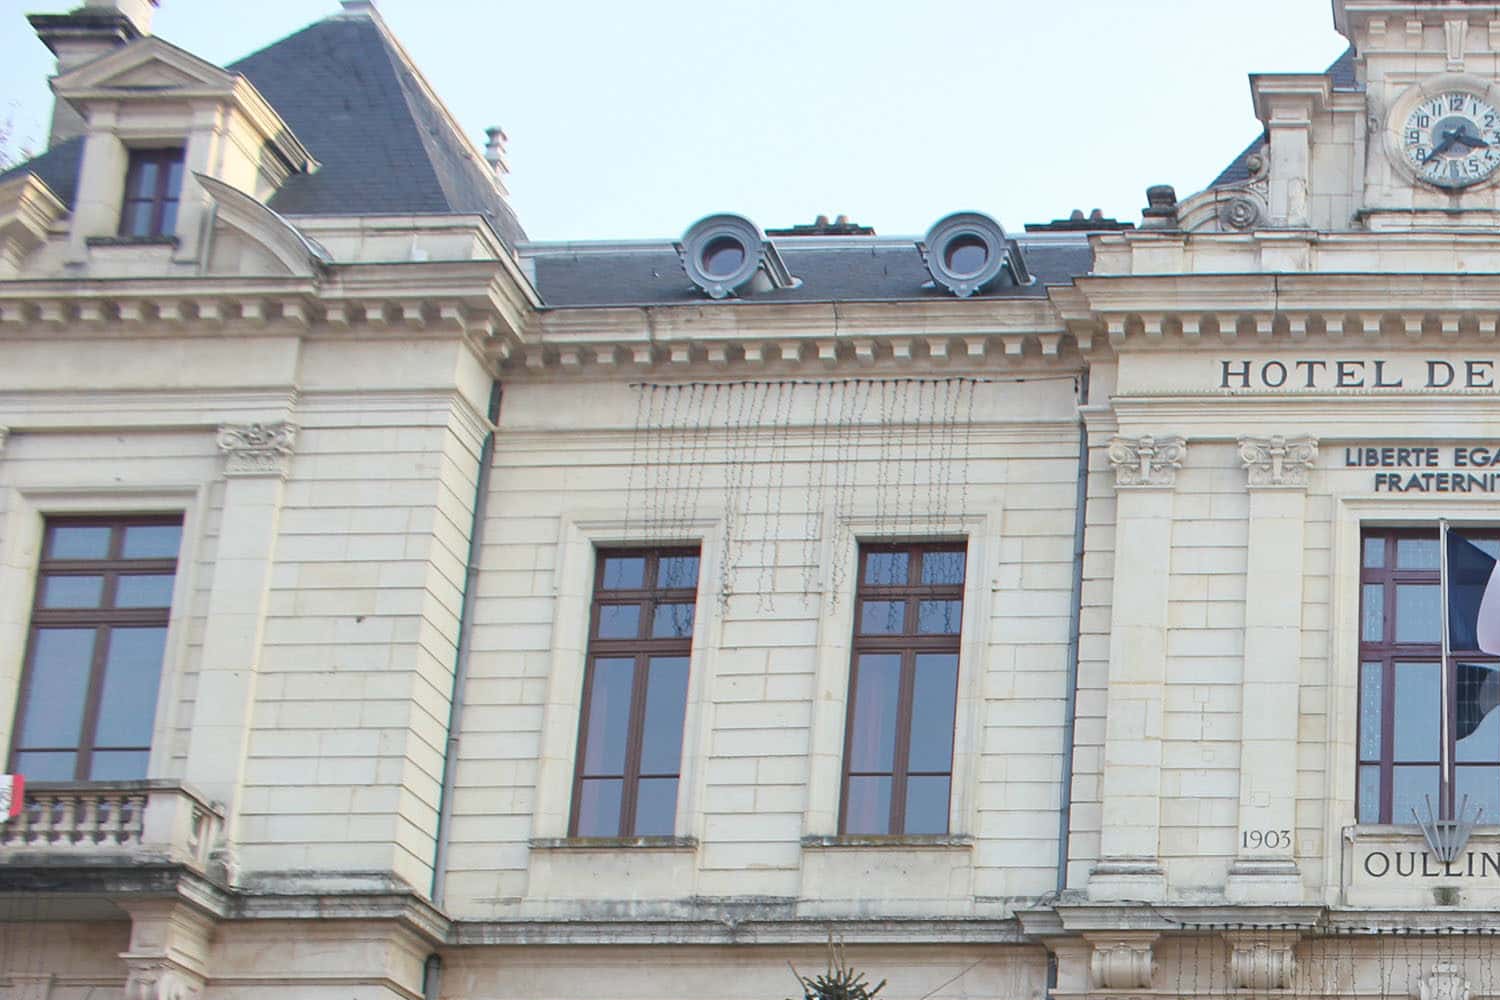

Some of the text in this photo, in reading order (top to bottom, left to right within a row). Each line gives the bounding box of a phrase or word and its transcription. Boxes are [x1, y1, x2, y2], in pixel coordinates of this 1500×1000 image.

[1432, 103, 1442, 116] 11
[1449, 98, 1464, 112] 12
[1416, 115, 1429, 128] 10
[1484, 114, 1495, 128] 2
[1409, 130, 1419, 144] 9
[1492, 131, 1500, 144] 3
[1415, 149, 1426, 161] 8
[1430, 159, 1441, 173] 7
[1468, 160, 1479, 173] 5
[1219, 360, 1403, 388] HOTEL
[1424, 360, 1494, 388] DE
[1345, 447, 1439, 468] LIBERTE
[1242, 829, 1292, 850] 1903
